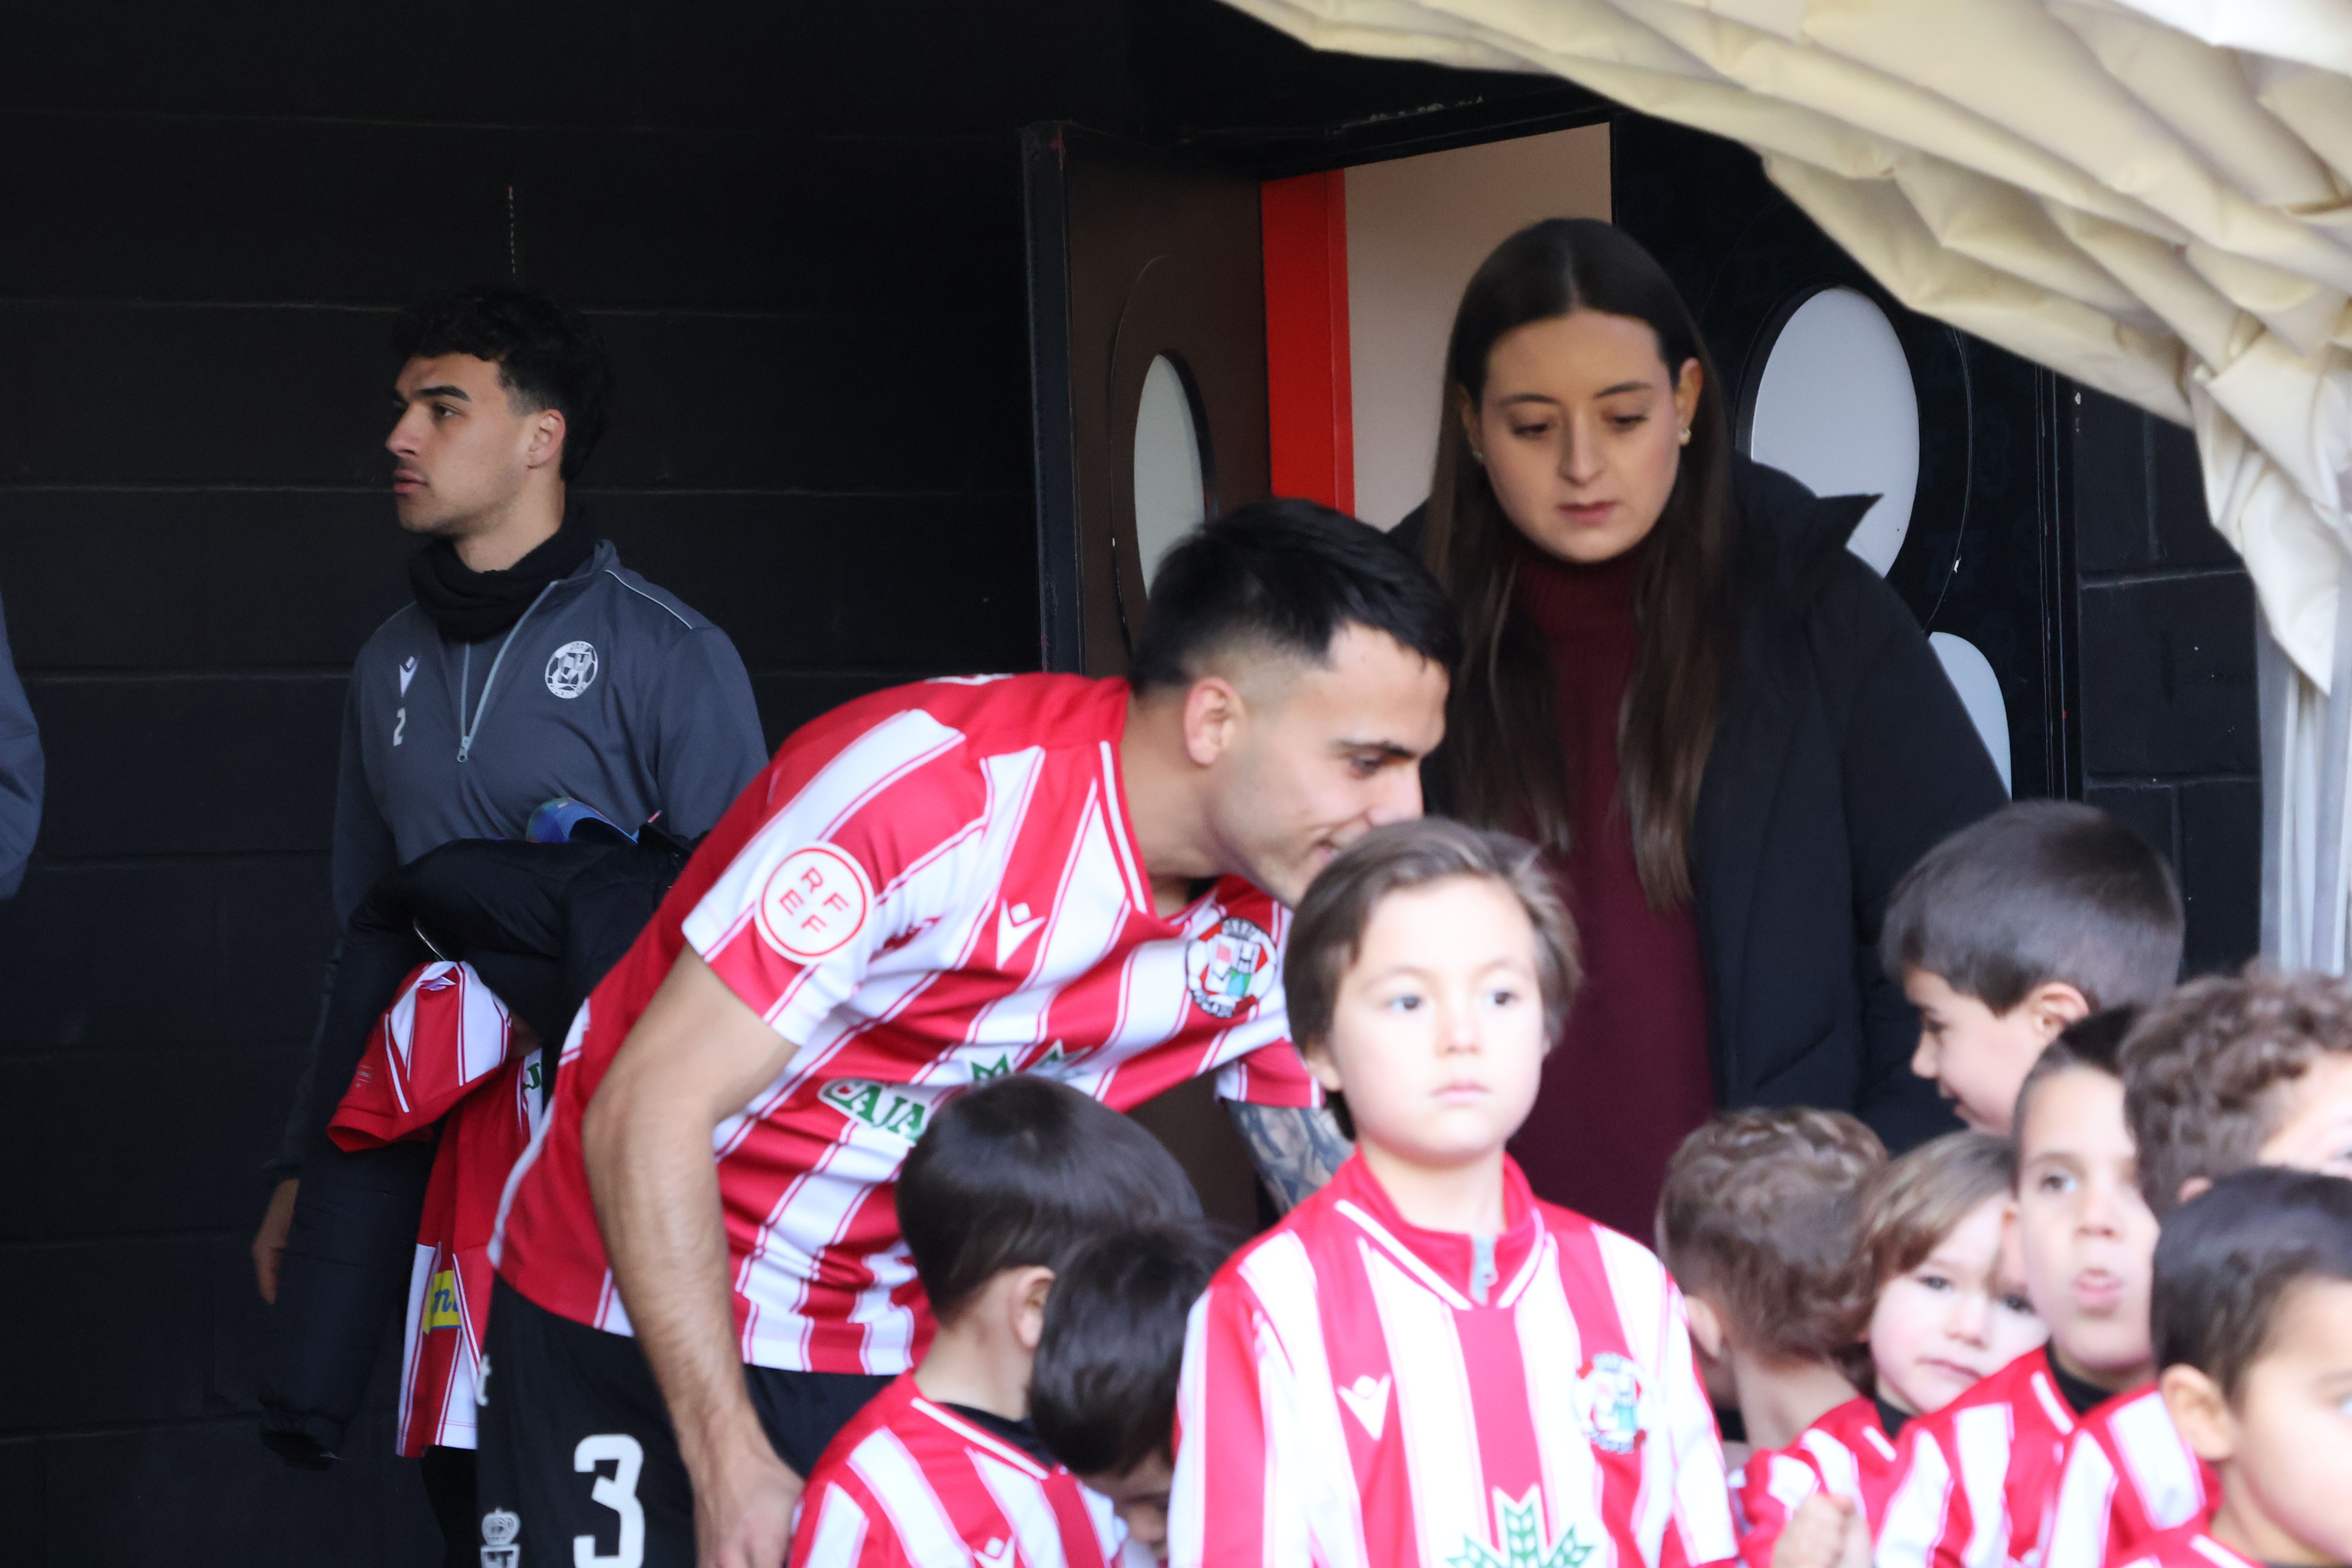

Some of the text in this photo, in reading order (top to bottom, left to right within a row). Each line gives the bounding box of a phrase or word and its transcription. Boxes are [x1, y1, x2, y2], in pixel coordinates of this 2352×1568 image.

[393, 707, 406, 746] 2
[823, 1079, 926, 1141] CAJA
[573, 1433, 646, 1568] 3
